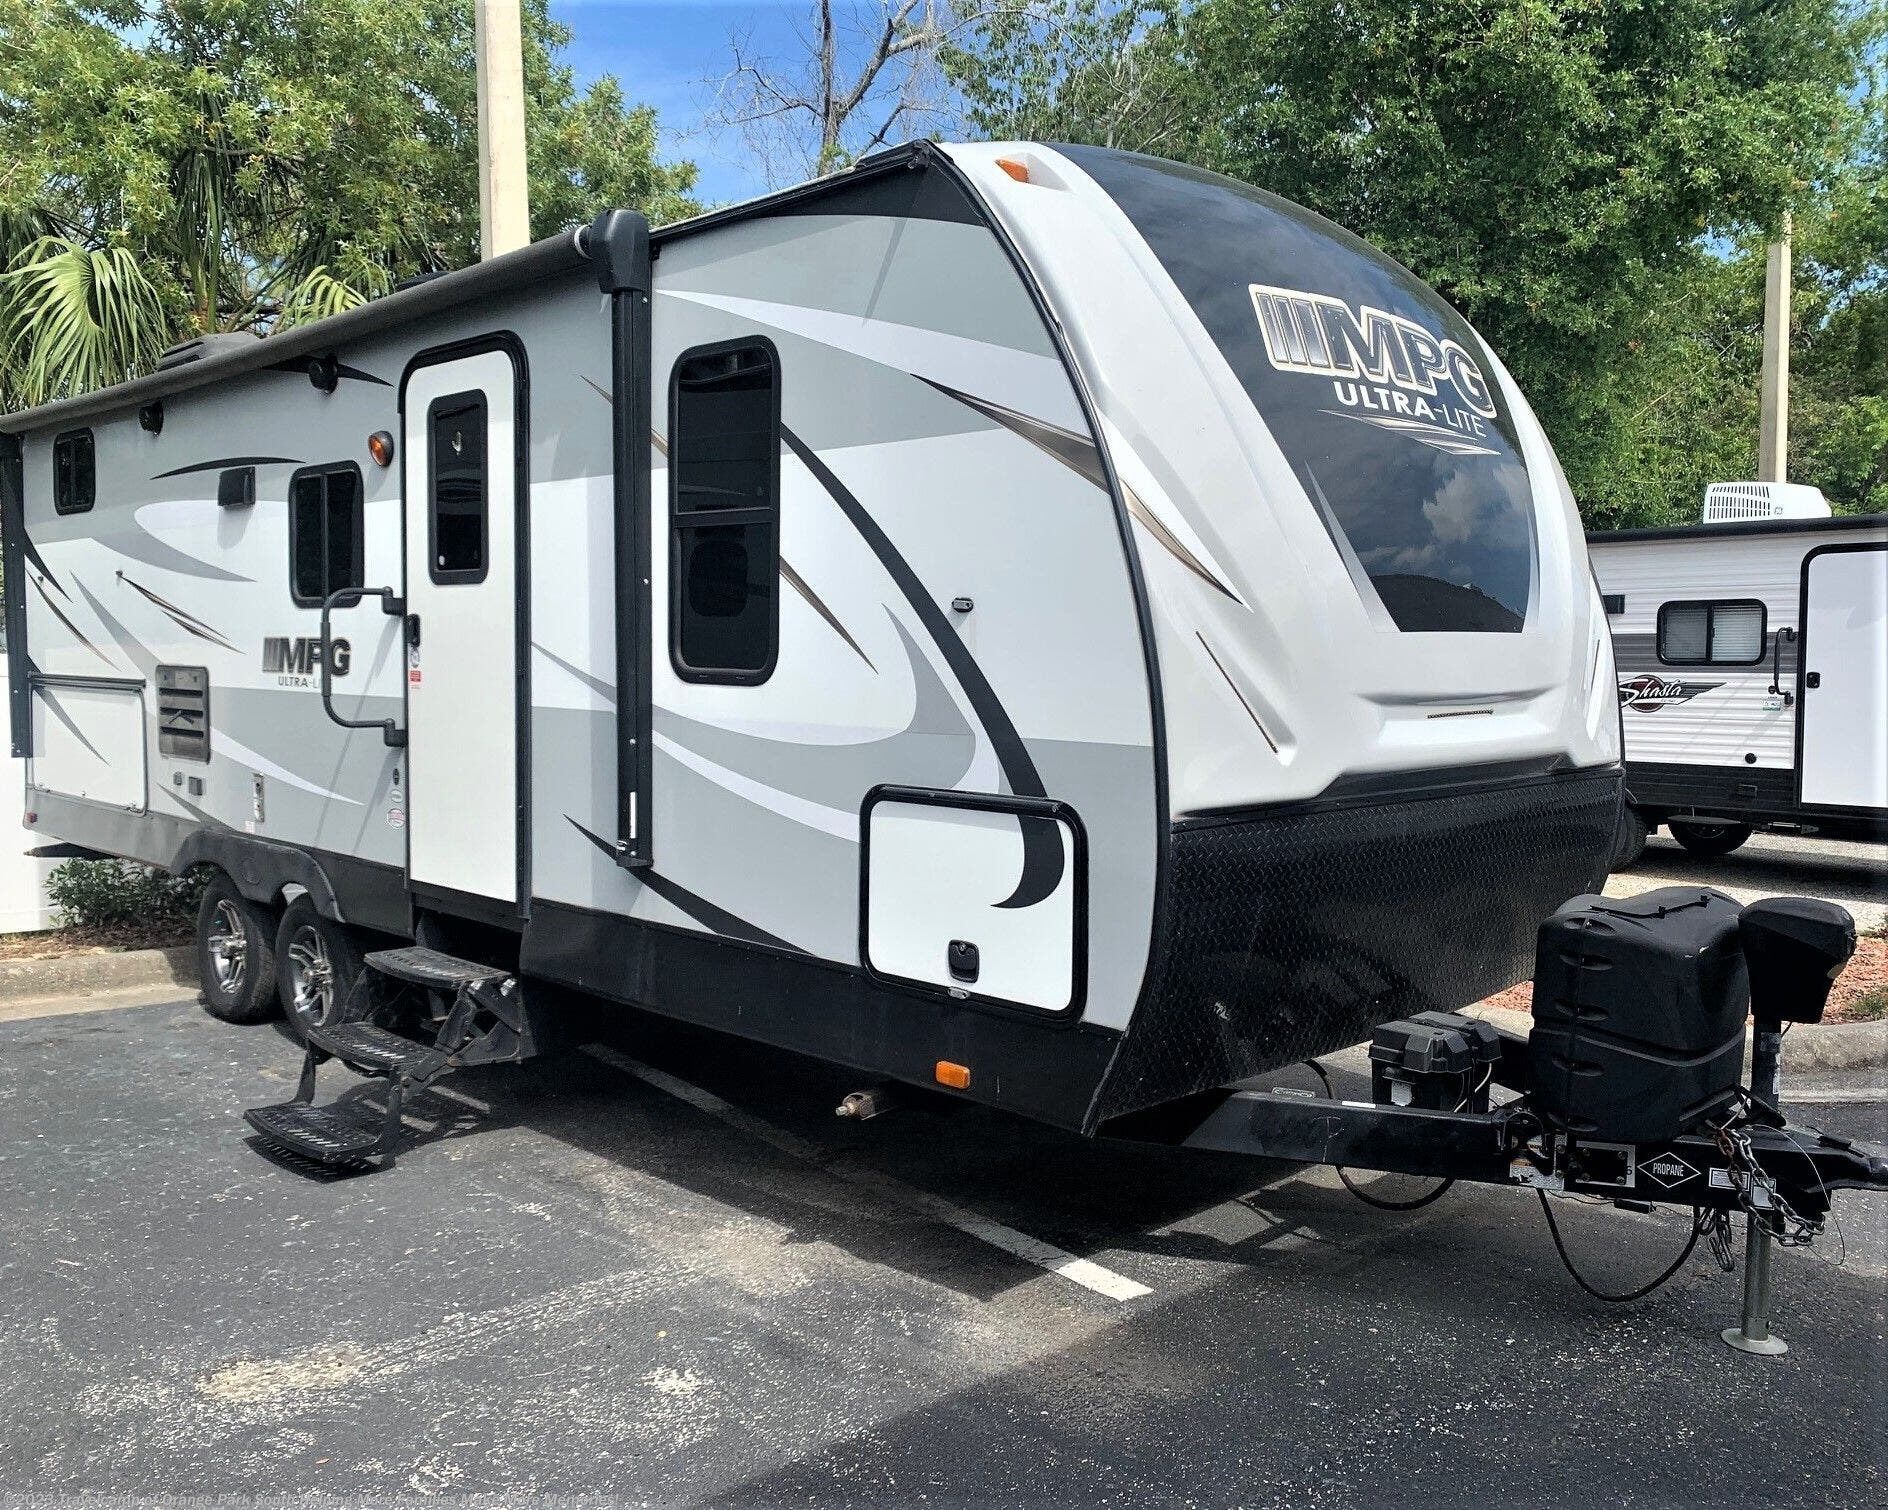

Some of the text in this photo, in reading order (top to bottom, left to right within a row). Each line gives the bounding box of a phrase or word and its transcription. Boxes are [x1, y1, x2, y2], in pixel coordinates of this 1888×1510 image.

[1333, 380, 1487, 438] ULTRA-LITE
[1618, 678, 1686, 709] Shasta
[1652, 1162, 1685, 1178] PROPANE
